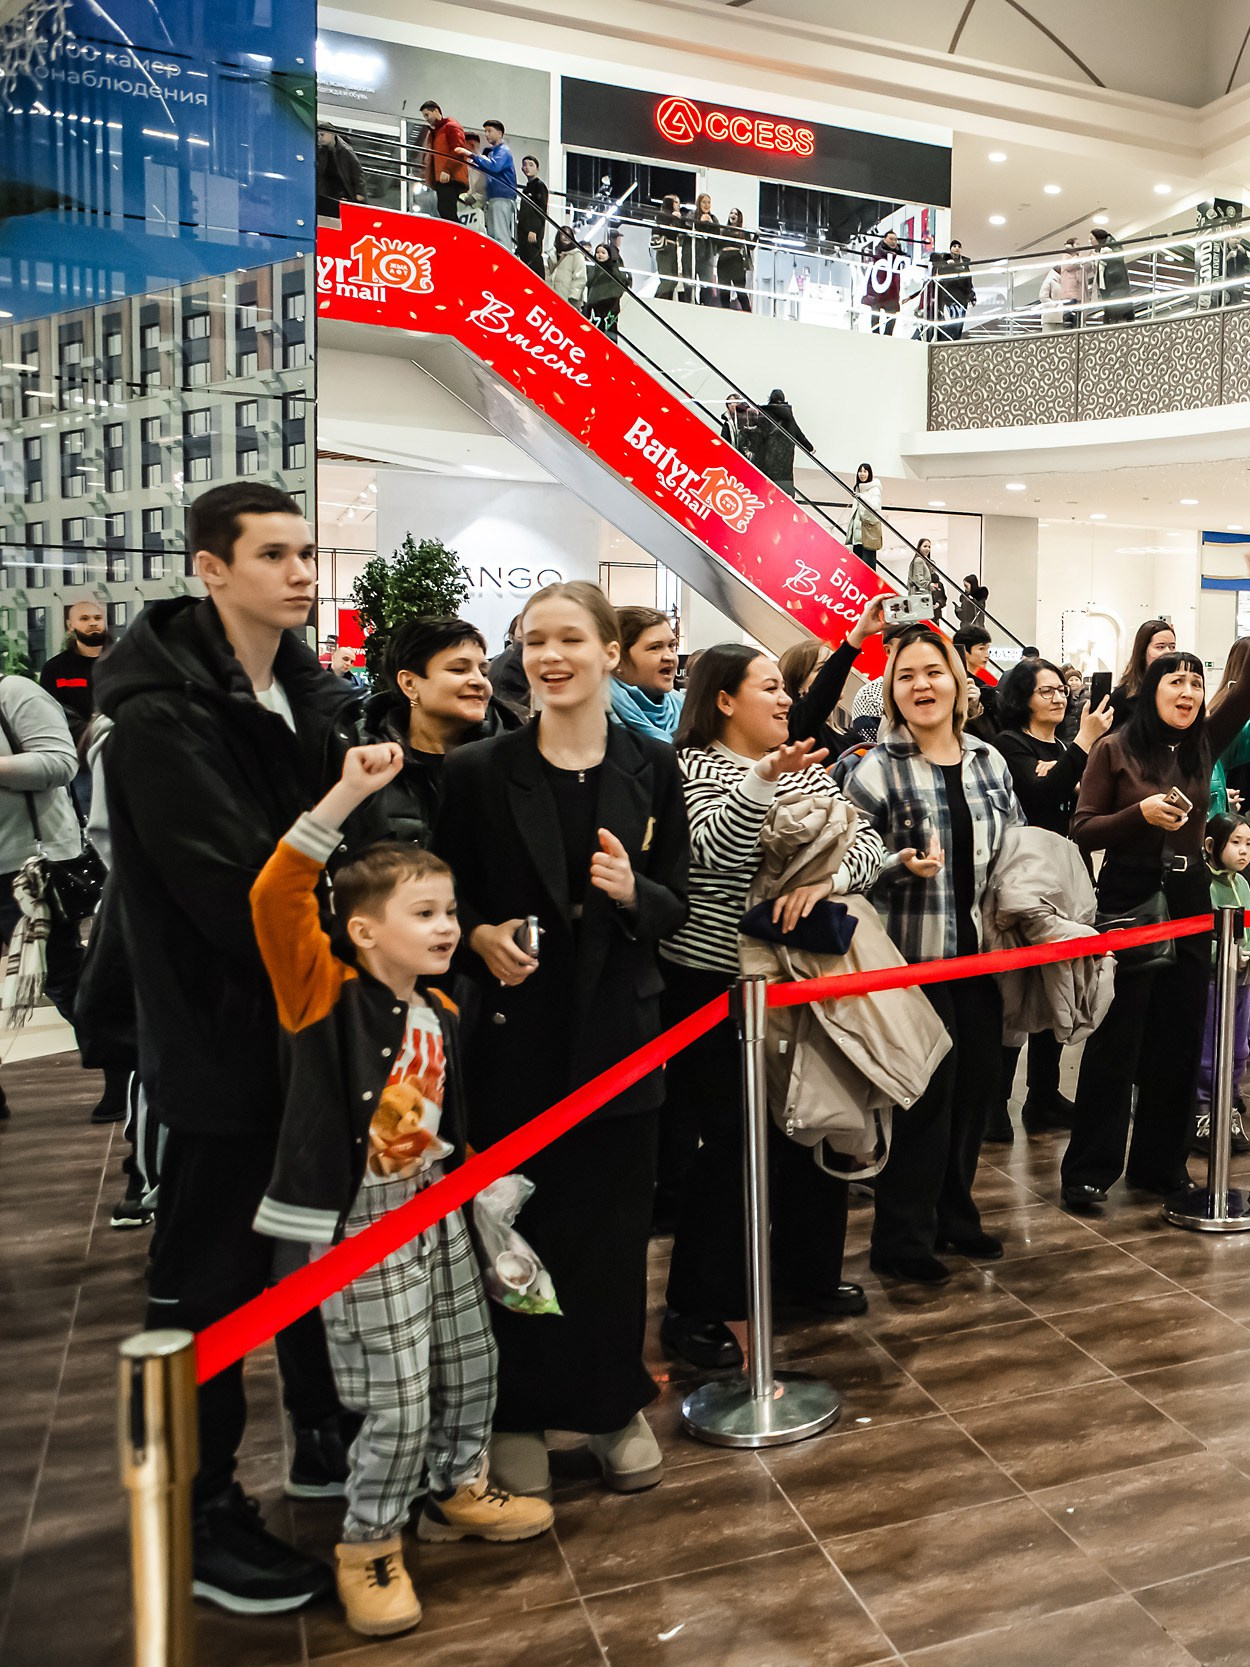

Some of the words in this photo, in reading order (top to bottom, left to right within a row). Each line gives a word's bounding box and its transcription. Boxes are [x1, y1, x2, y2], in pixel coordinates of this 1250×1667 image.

[34, 65, 209, 106] онаблюдения
[106, 53, 182, 79] камер
[657, 97, 815, 156] ACCESS
[317, 254, 353, 293] yr
[336, 281, 386, 303] mall
[466, 291, 591, 387] Вместе
[525, 304, 586, 364] Бірге
[623, 416, 700, 490] Batyr
[674, 487, 712, 521] mall
[453, 566, 563, 589] ANGO
[782, 559, 861, 623] Вмес
[829, 567, 871, 606] Бірг
